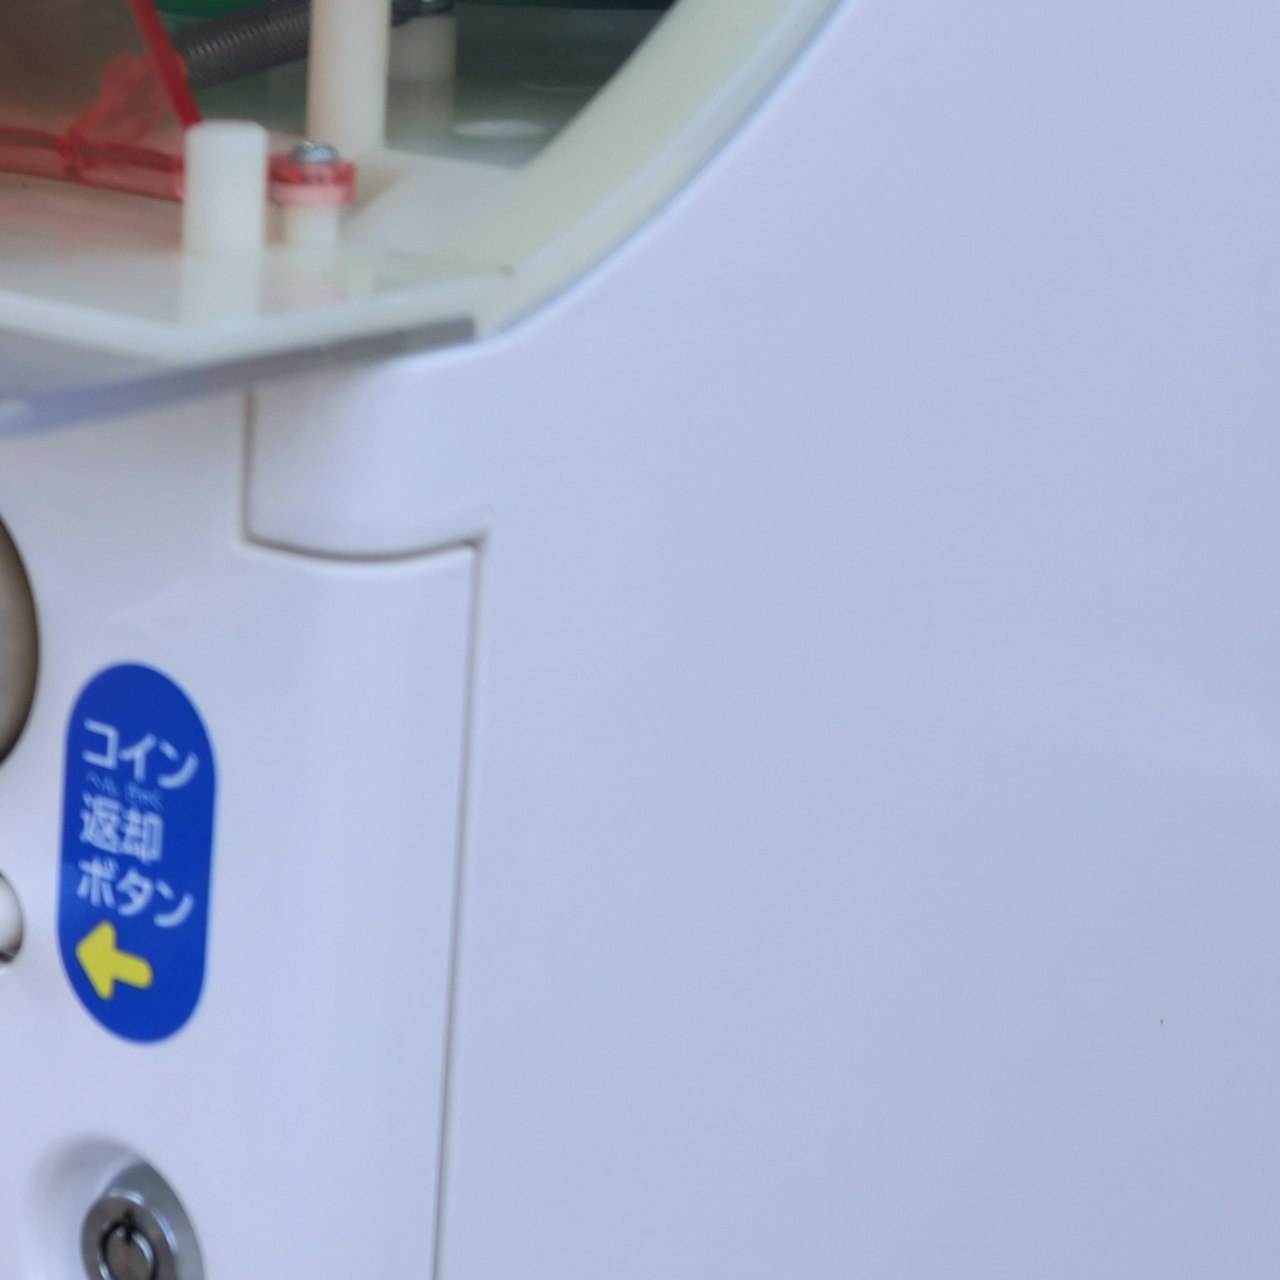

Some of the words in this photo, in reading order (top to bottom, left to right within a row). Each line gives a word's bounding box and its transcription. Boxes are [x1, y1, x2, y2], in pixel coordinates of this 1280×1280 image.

[83, 718, 199, 789] コイン
[79, 791, 164, 864] 返却
[77, 856, 194, 928] ボタン
